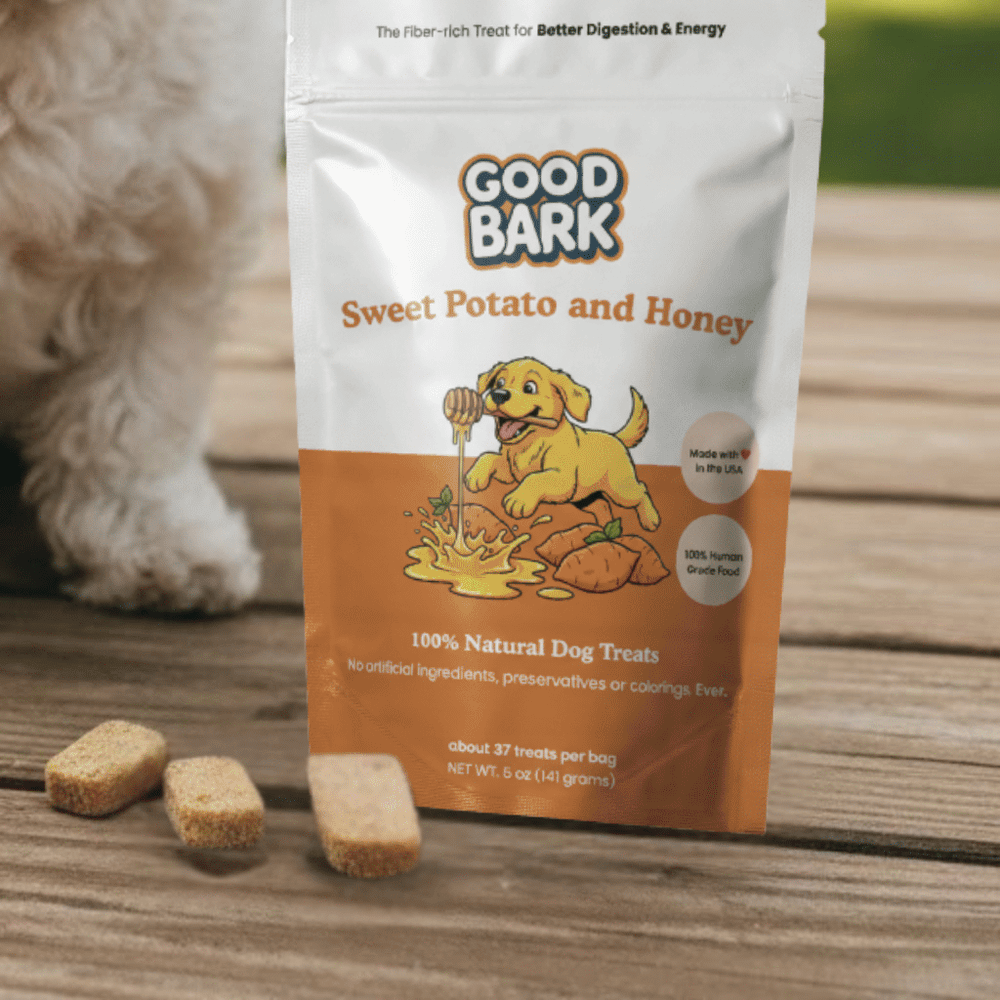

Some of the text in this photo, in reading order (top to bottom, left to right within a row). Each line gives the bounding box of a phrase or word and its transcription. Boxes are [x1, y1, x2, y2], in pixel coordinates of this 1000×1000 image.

[376, 21, 727, 39] The Fiber-rich Treat for Better Digestion & Energy
[462, 152, 624, 202] GOOD
[468, 201, 620, 262] BARK
[341, 289, 754, 345] Sweet Potato and Honey
[689, 449, 739, 459] Made with
[696, 463, 743, 475] in the USA
[685, 550, 743, 562] 100% Human
[687, 565, 740, 576] Grade Food
[411, 632, 660, 664] 100% Natural Dog Treats
[348, 658, 364, 672] No
[366, 660, 413, 676] artificial
[417, 663, 499, 685] ingredients,
[502, 671, 606, 691] preservatives
[609, 681, 626, 691] or
[695, 682, 729, 698] Ever.
[448, 740, 617, 768] about 37 treats per bag
[447, 761, 616, 789] NET WT. 5 oz (141 grams)
